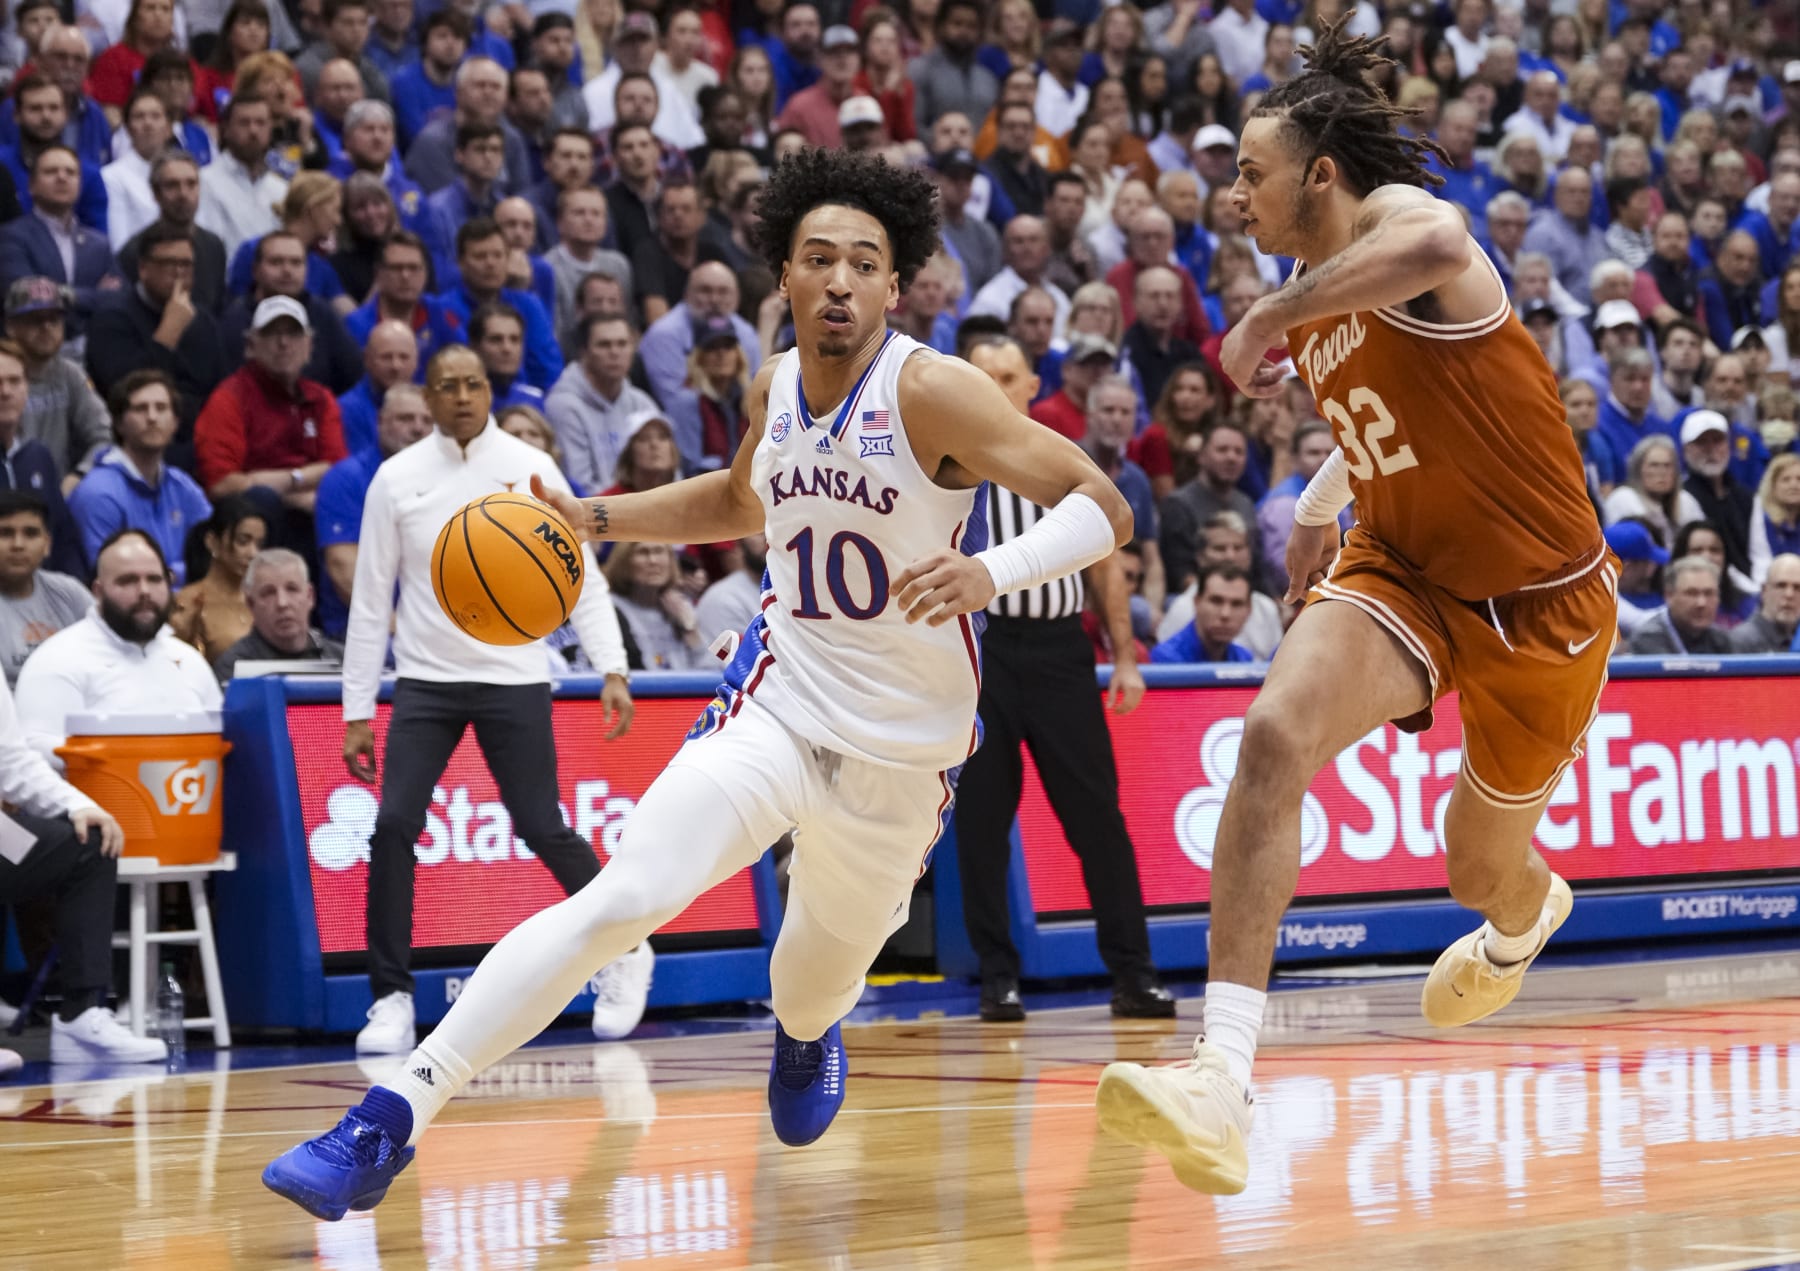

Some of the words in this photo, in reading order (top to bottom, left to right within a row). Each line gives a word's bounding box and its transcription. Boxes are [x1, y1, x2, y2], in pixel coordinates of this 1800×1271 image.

[1298, 312, 1366, 400] Texas
[1322, 386, 1420, 480] 32
[769, 465, 900, 515] KANSAS
[533, 520, 582, 587] NCAA
[786, 526, 890, 620] 10
[1335, 712, 1799, 861] SteFarm
[1286, 924, 1367, 949] Mortgage
